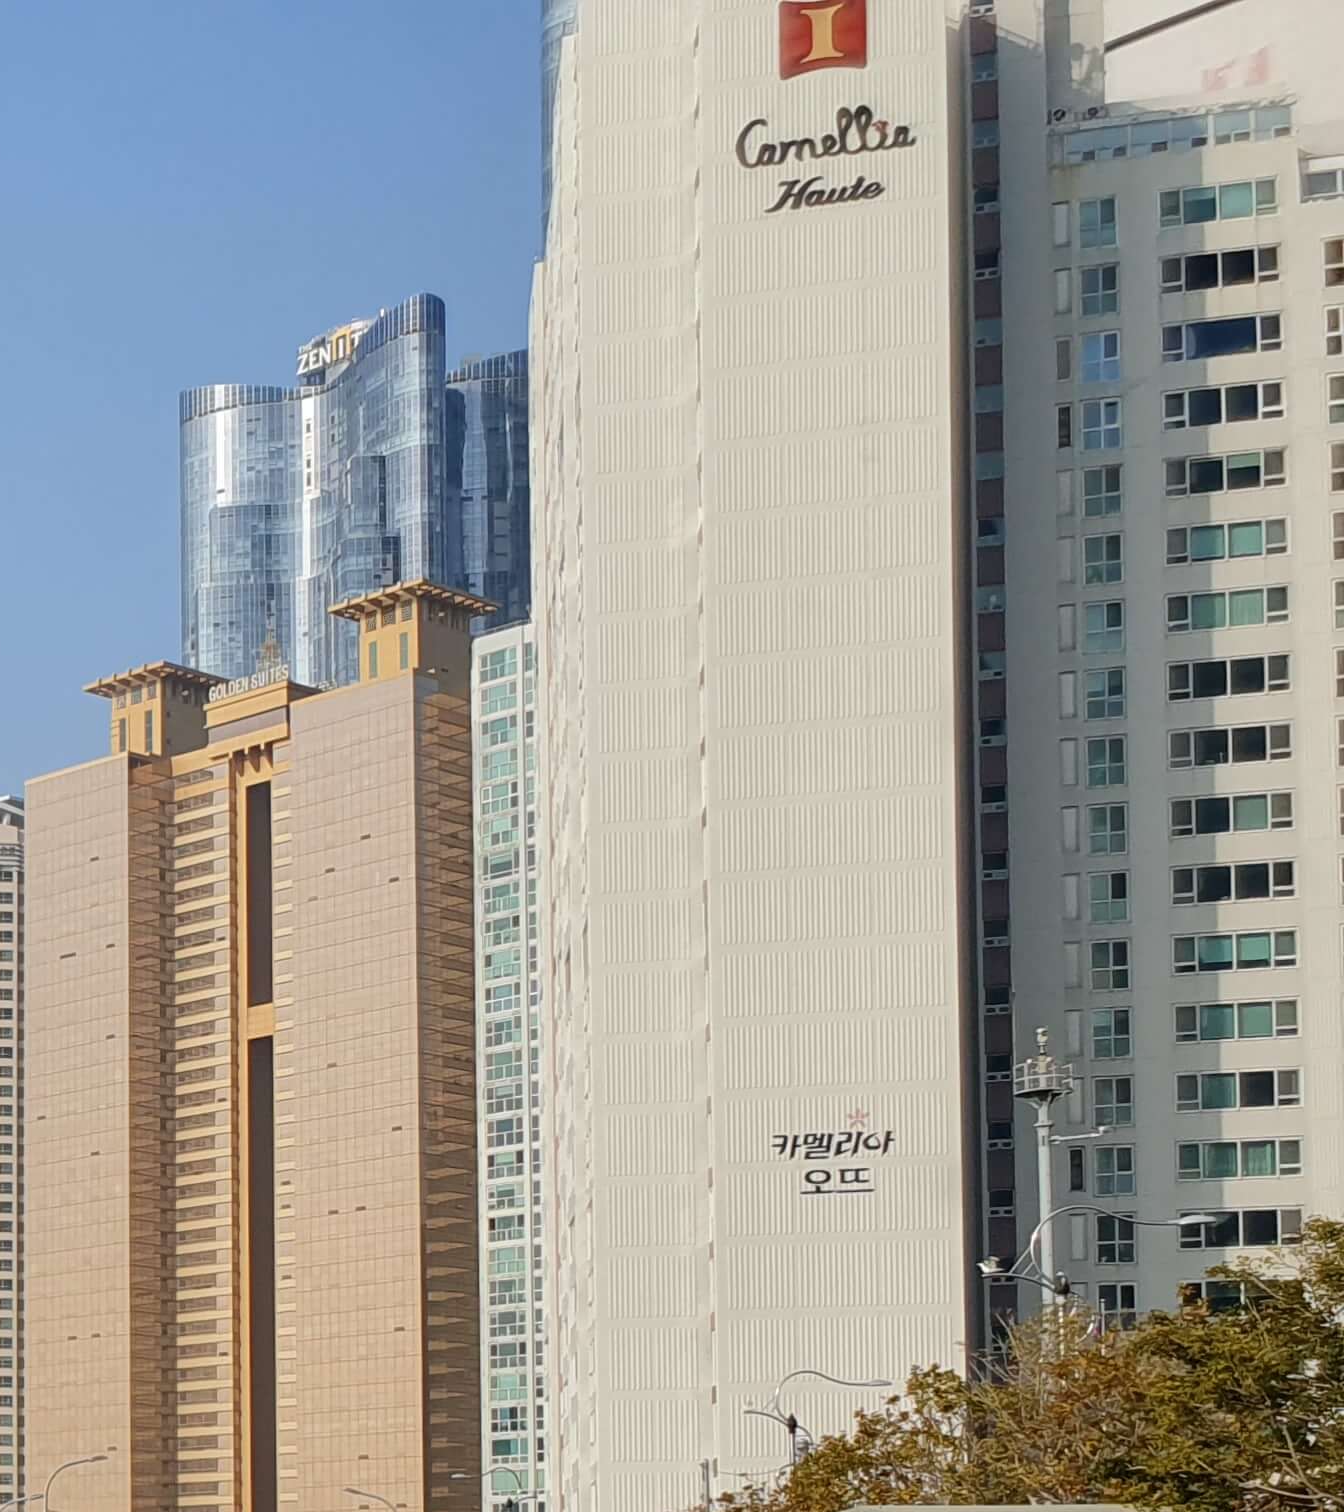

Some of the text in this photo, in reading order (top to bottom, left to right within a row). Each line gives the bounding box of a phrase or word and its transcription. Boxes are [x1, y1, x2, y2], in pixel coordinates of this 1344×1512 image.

[736, 105, 916, 168] Camellia
[764, 176, 886, 214] Haute
[209, 663, 289, 702] GOLDEN SUITES
[771, 1130, 895, 1160] 카멜리아
[800, 1168, 875, 1194] 오뜨
